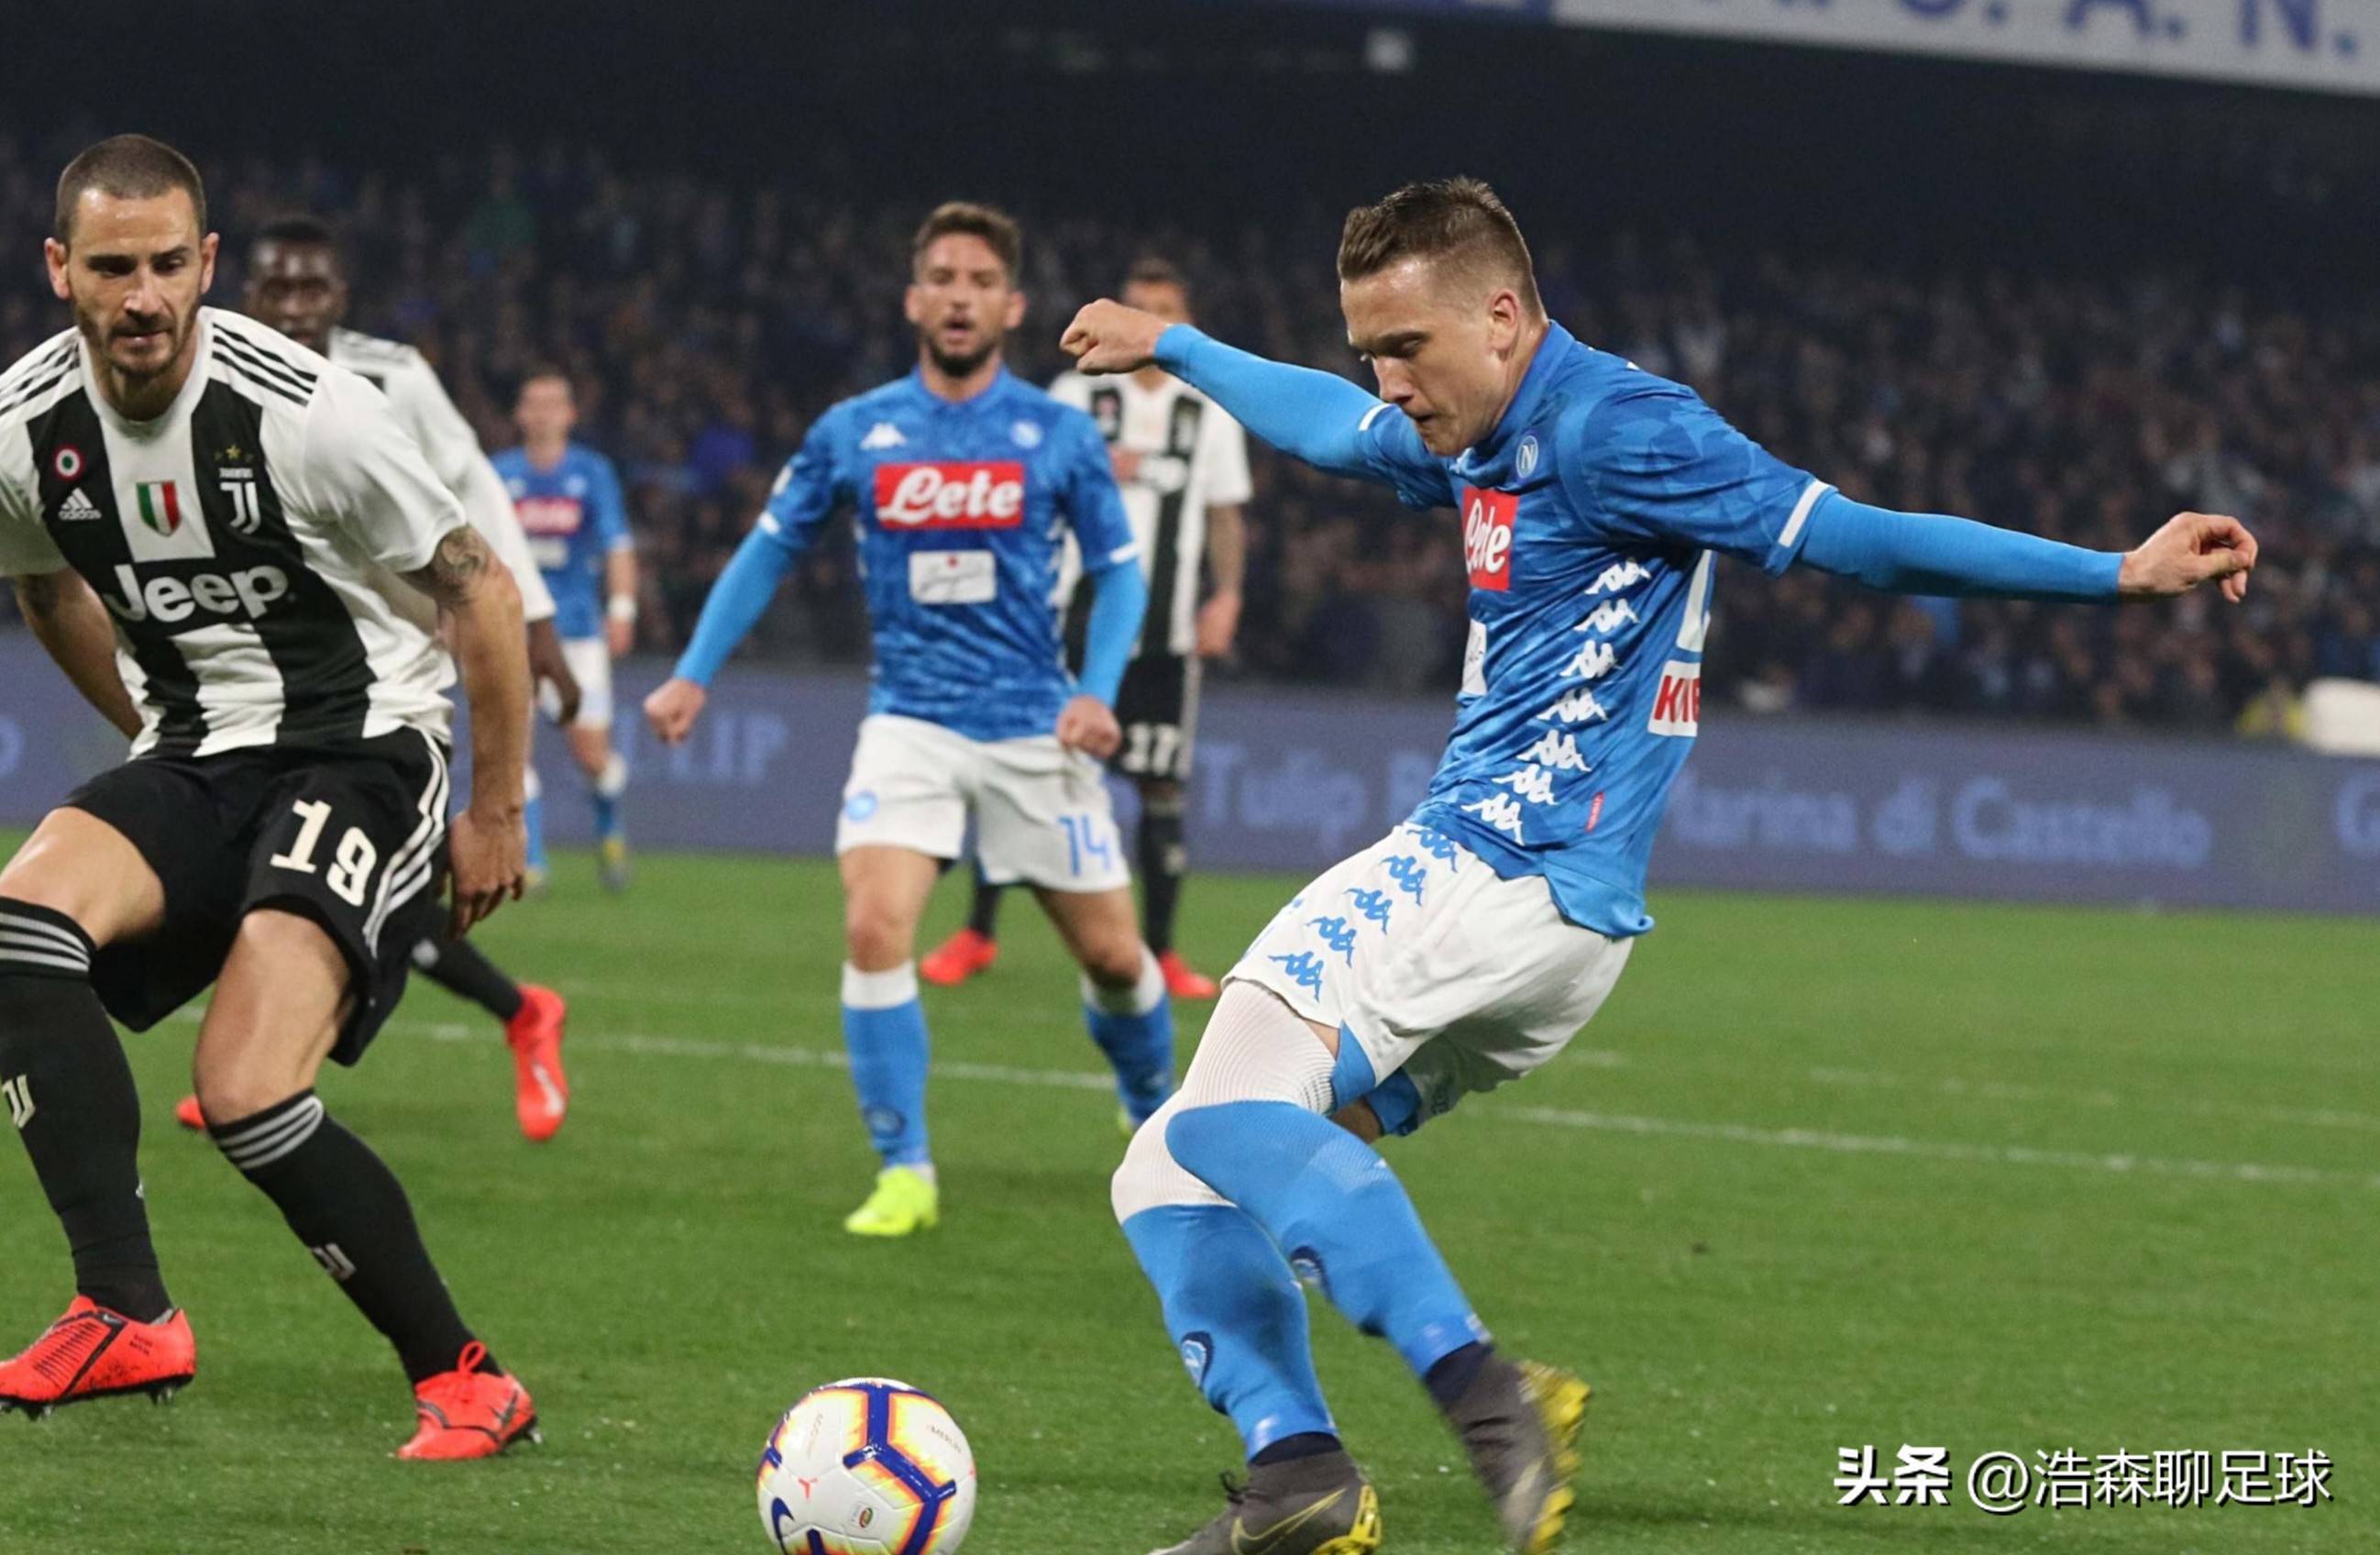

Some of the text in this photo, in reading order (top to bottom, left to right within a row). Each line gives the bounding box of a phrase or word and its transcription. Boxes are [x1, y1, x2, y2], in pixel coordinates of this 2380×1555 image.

[58, 508, 102, 520] adidas
[878, 466, 1023, 524] Lete
[105, 565, 289, 623] Jeep
[1122, 722, 1179, 774] 17
[271, 800, 378, 906] 19
[1060, 816, 1112, 877] 14
